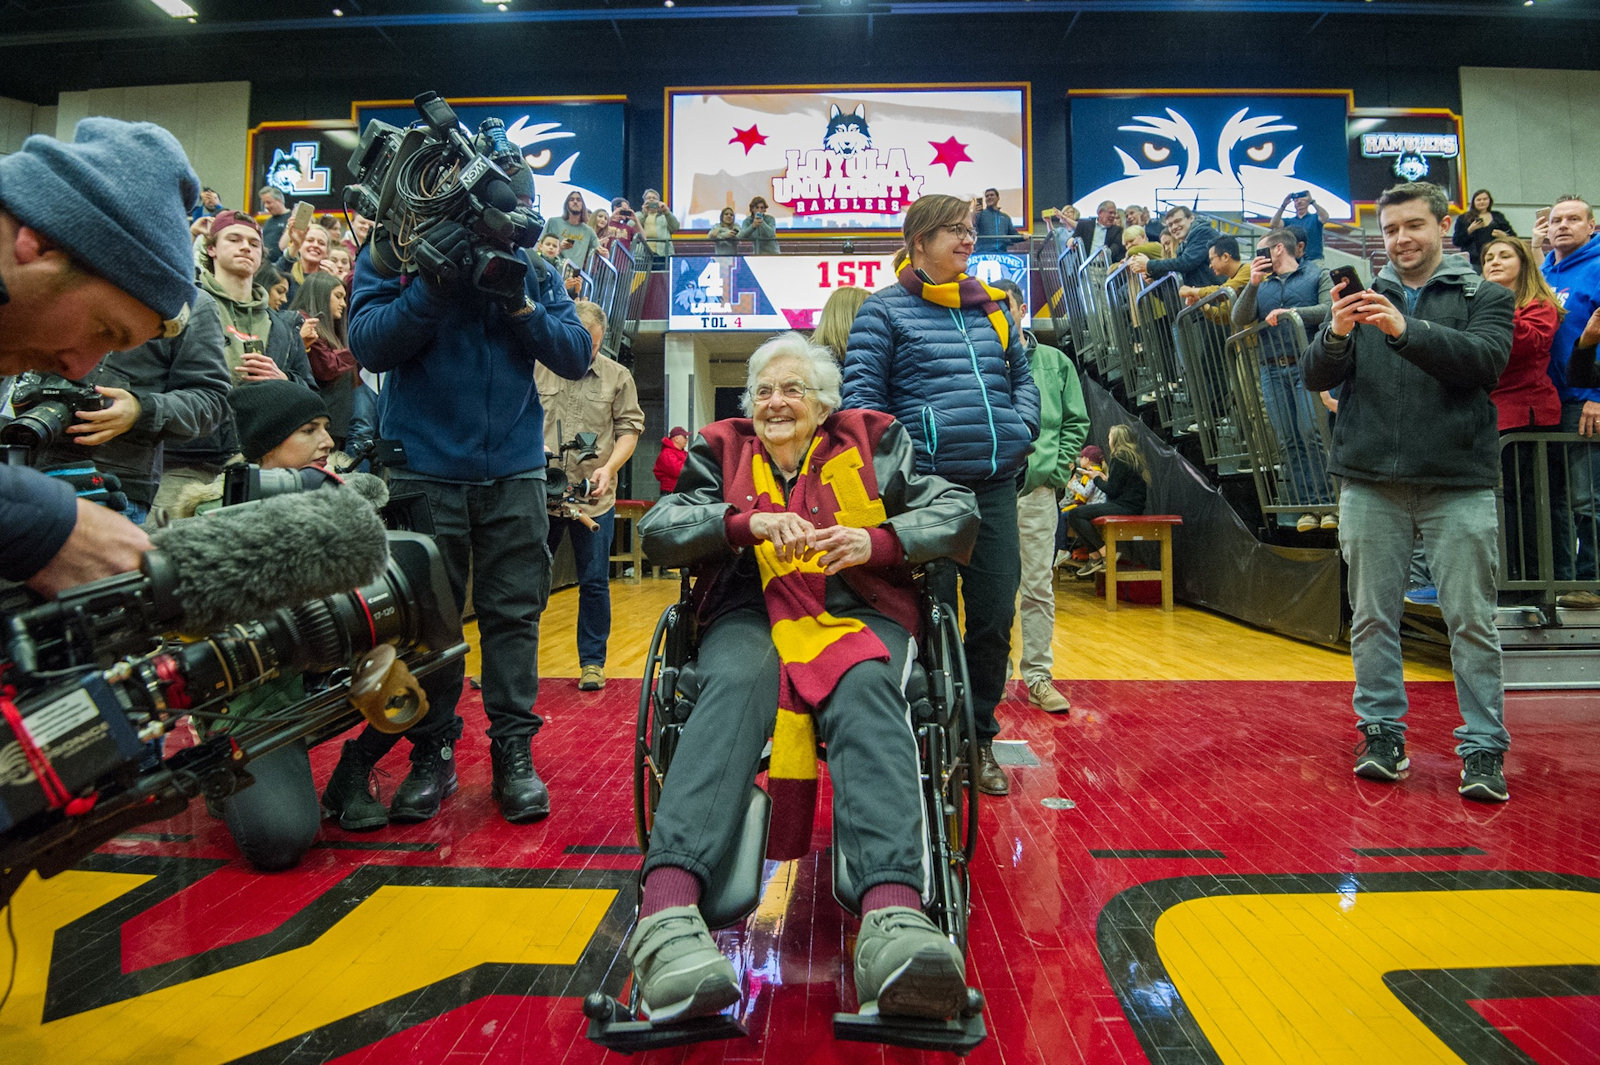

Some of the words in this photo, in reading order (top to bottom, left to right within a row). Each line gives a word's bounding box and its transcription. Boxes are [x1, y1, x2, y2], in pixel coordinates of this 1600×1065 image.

[1363, 134, 1457, 155] RAMBLERS
[290, 142, 331, 195] L
[461, 158, 487, 187] WGN
[785, 148, 911, 178] LOYOLA
[771, 176, 924, 203] UNIVERSITY
[796, 199, 900, 213] RAMBLERS
[986, 254, 1021, 267] WAYNE
[697, 261, 724, 297] 4
[817, 261, 881, 288] 1ST
[701, 317, 727, 328] TOL
[734, 317, 742, 328] 4
